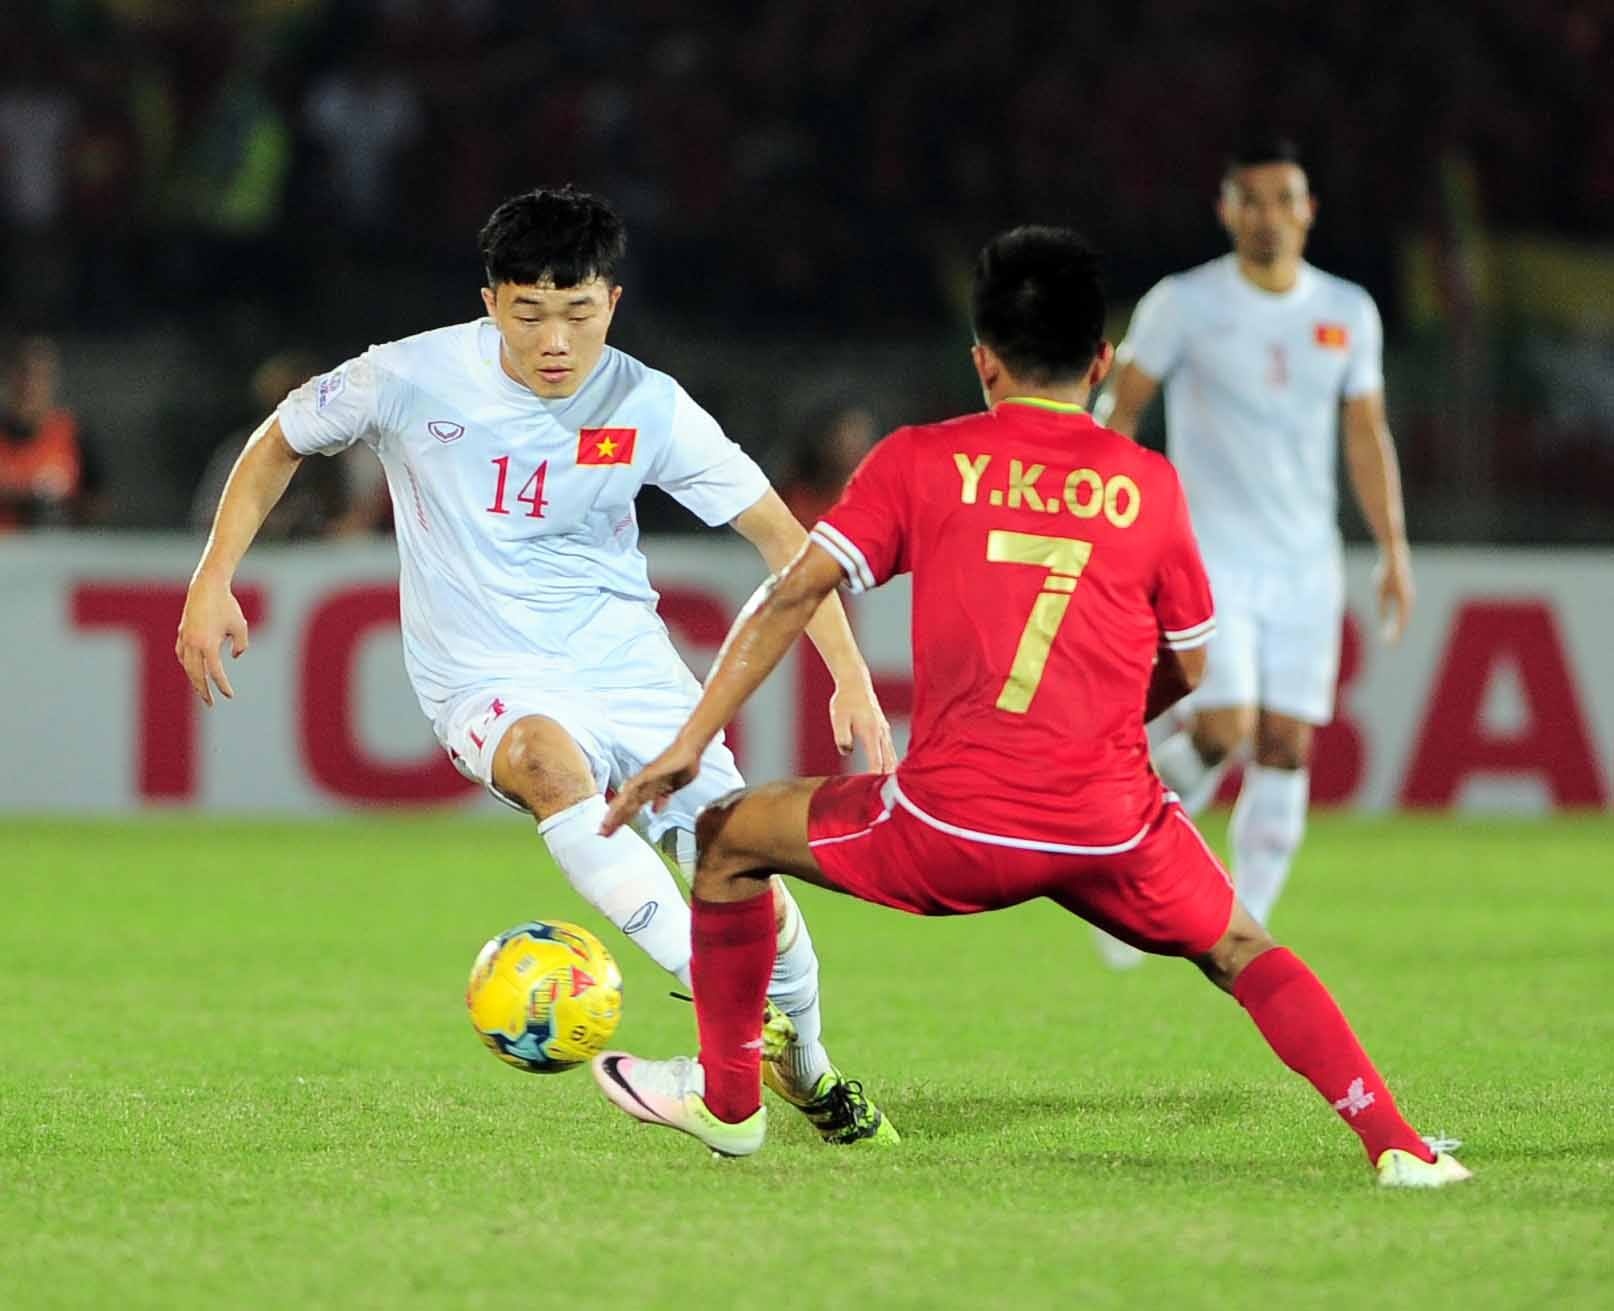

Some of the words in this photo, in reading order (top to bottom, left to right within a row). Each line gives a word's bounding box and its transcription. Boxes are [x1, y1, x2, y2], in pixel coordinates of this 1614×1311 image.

[485, 455, 549, 519] 14
[953, 453, 1141, 528] Y.K.OO
[986, 529, 1093, 714] 7
